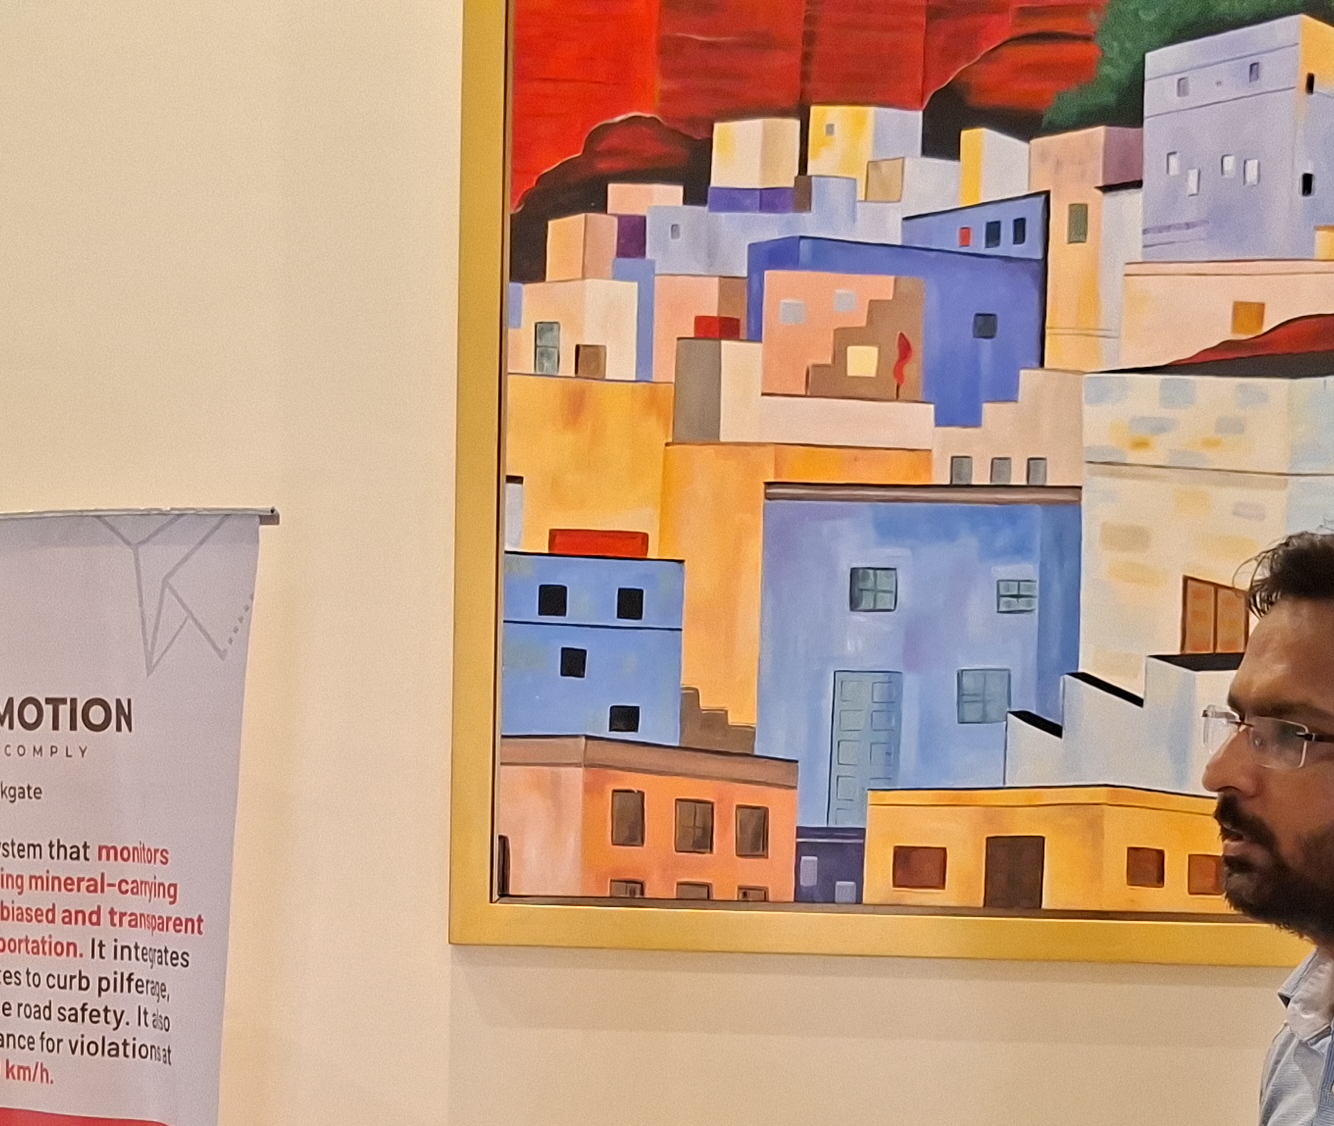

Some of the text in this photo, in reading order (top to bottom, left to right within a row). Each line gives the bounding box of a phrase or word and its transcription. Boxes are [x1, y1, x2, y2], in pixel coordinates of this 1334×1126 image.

[4, 745, 88, 758] COMPLY
[48, 838, 90, 861] that
[97, 841, 170, 865] monitors
[28, 868, 178, 905] mineral-carrying
[61, 904, 101, 927] and
[108, 906, 204, 936] transparent
[90, 937, 106, 960] It
[113, 938, 189, 969] integrates
[26, 967, 41, 988] to
[46, 969, 90, 991] curb
[17, 999, 52, 1021] road
[57, 1002, 130, 1031] safety.
[137, 1005, 149, 1027] It
[40, 1031, 63, 1054] for
[68, 1033, 161, 1062] violations
[162, 1045, 172, 1066] at
[5, 1058, 54, 1084] km/h.
